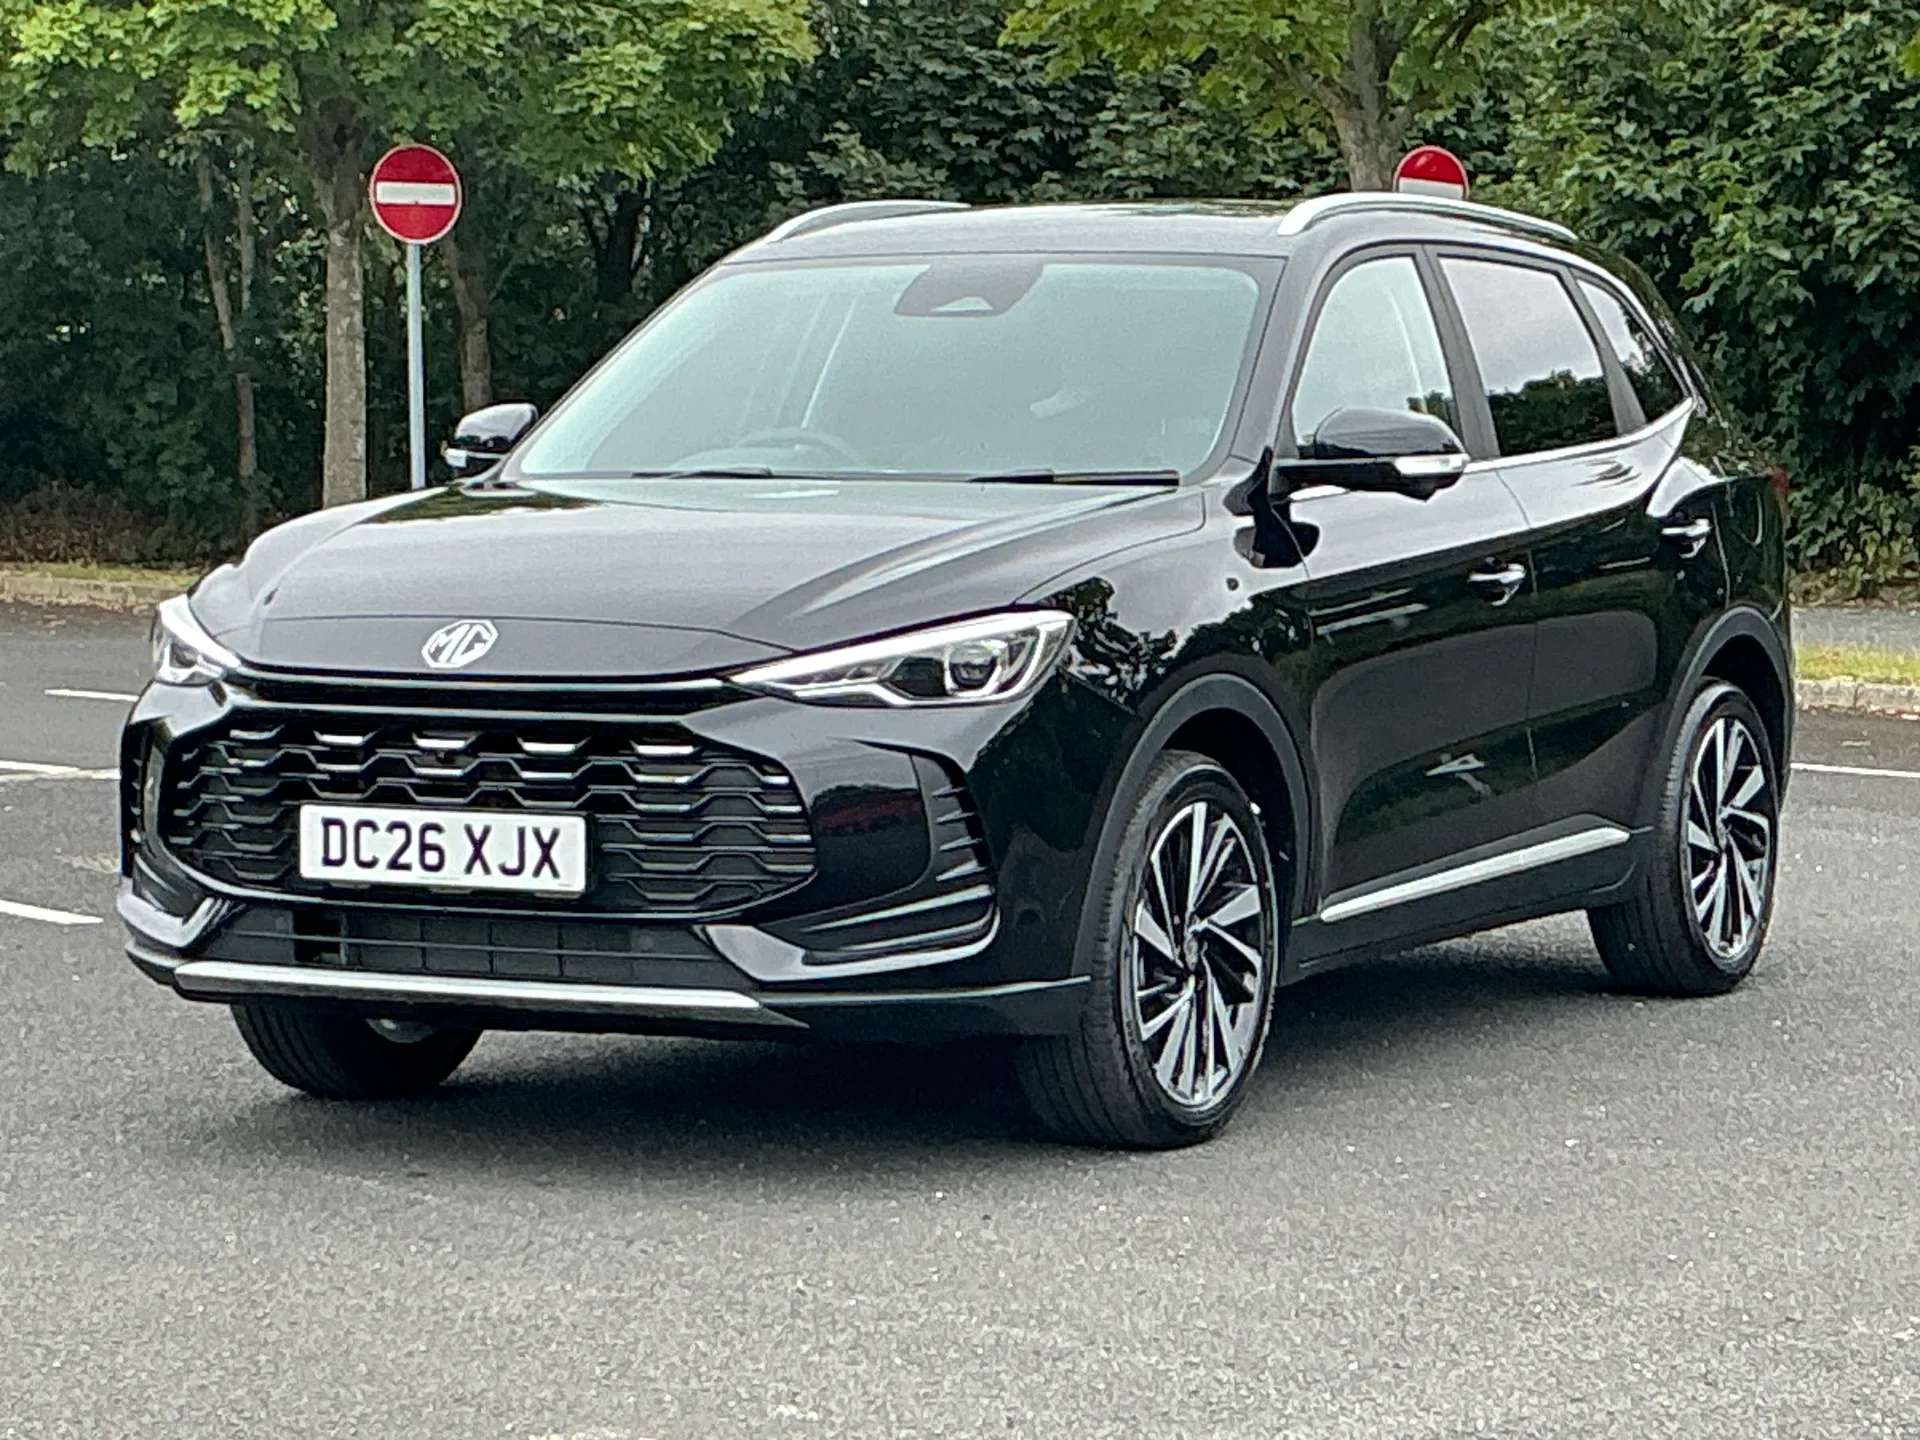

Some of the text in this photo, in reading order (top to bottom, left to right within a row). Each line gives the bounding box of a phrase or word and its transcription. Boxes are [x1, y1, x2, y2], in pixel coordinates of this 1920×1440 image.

[423, 620, 497, 667] MG
[321, 816, 561, 879] DC26 XJX
